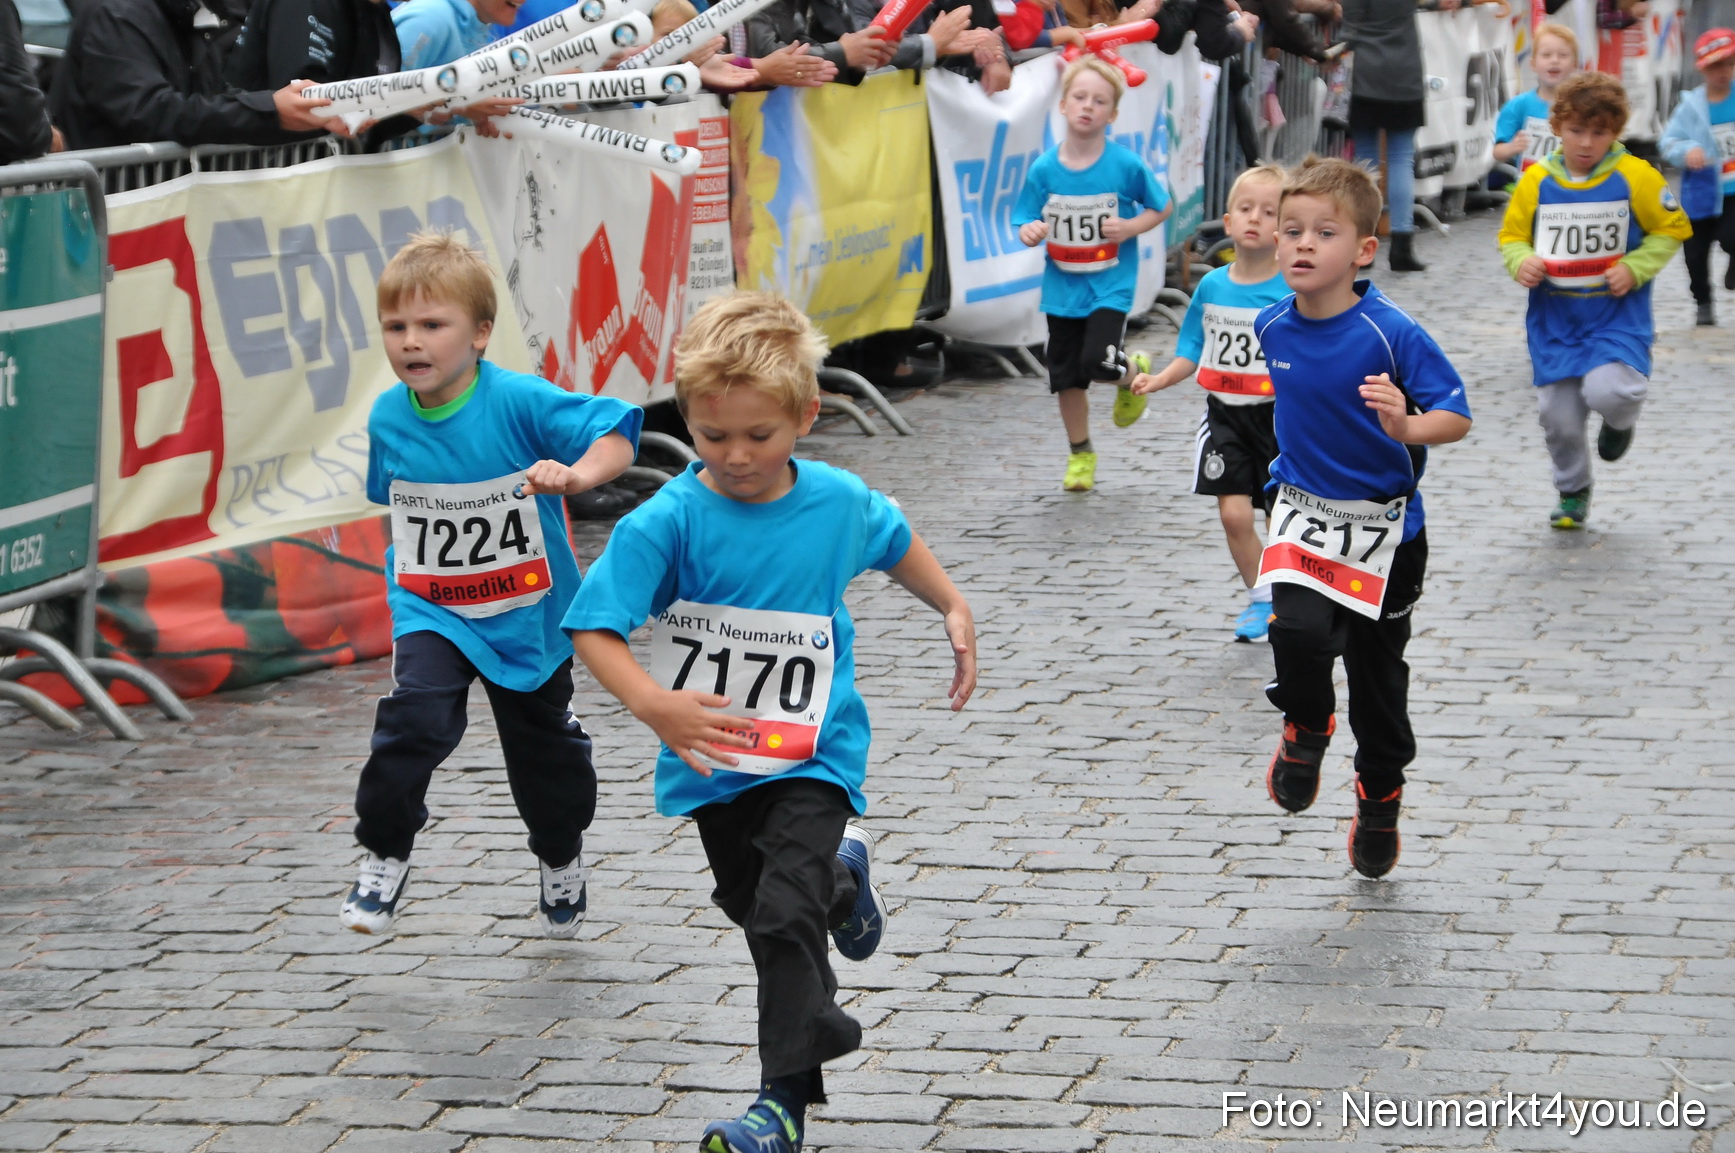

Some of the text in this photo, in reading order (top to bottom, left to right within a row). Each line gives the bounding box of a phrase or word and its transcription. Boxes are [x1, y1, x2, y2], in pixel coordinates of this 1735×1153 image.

[588, 76, 647, 100] BMW
[590, 125, 650, 153] BMW
[1065, 202, 1105, 211] Neumarkt
[1541, 210, 1615, 222] PARTL Neumarkt
[1548, 222, 1621, 255] 7053
[1221, 375, 1244, 391] Phil
[393, 491, 507, 511] PARTL Neumarkt
[1315, 500, 1382, 522] Neumarkt
[406, 508, 531, 568] 7224
[1277, 498, 1389, 564] 7217
[10, 533, 44, 574] 6352
[532, 548, 540, 557] K
[401, 562, 407, 572] 2
[1300, 554, 1335, 584] Nico
[1377, 566, 1384, 575] K
[429, 573, 518, 601] Benedikt
[658, 609, 805, 646] PARTL Neumarkt
[671, 635, 817, 714] 7170
[808, 712, 817, 723] K
